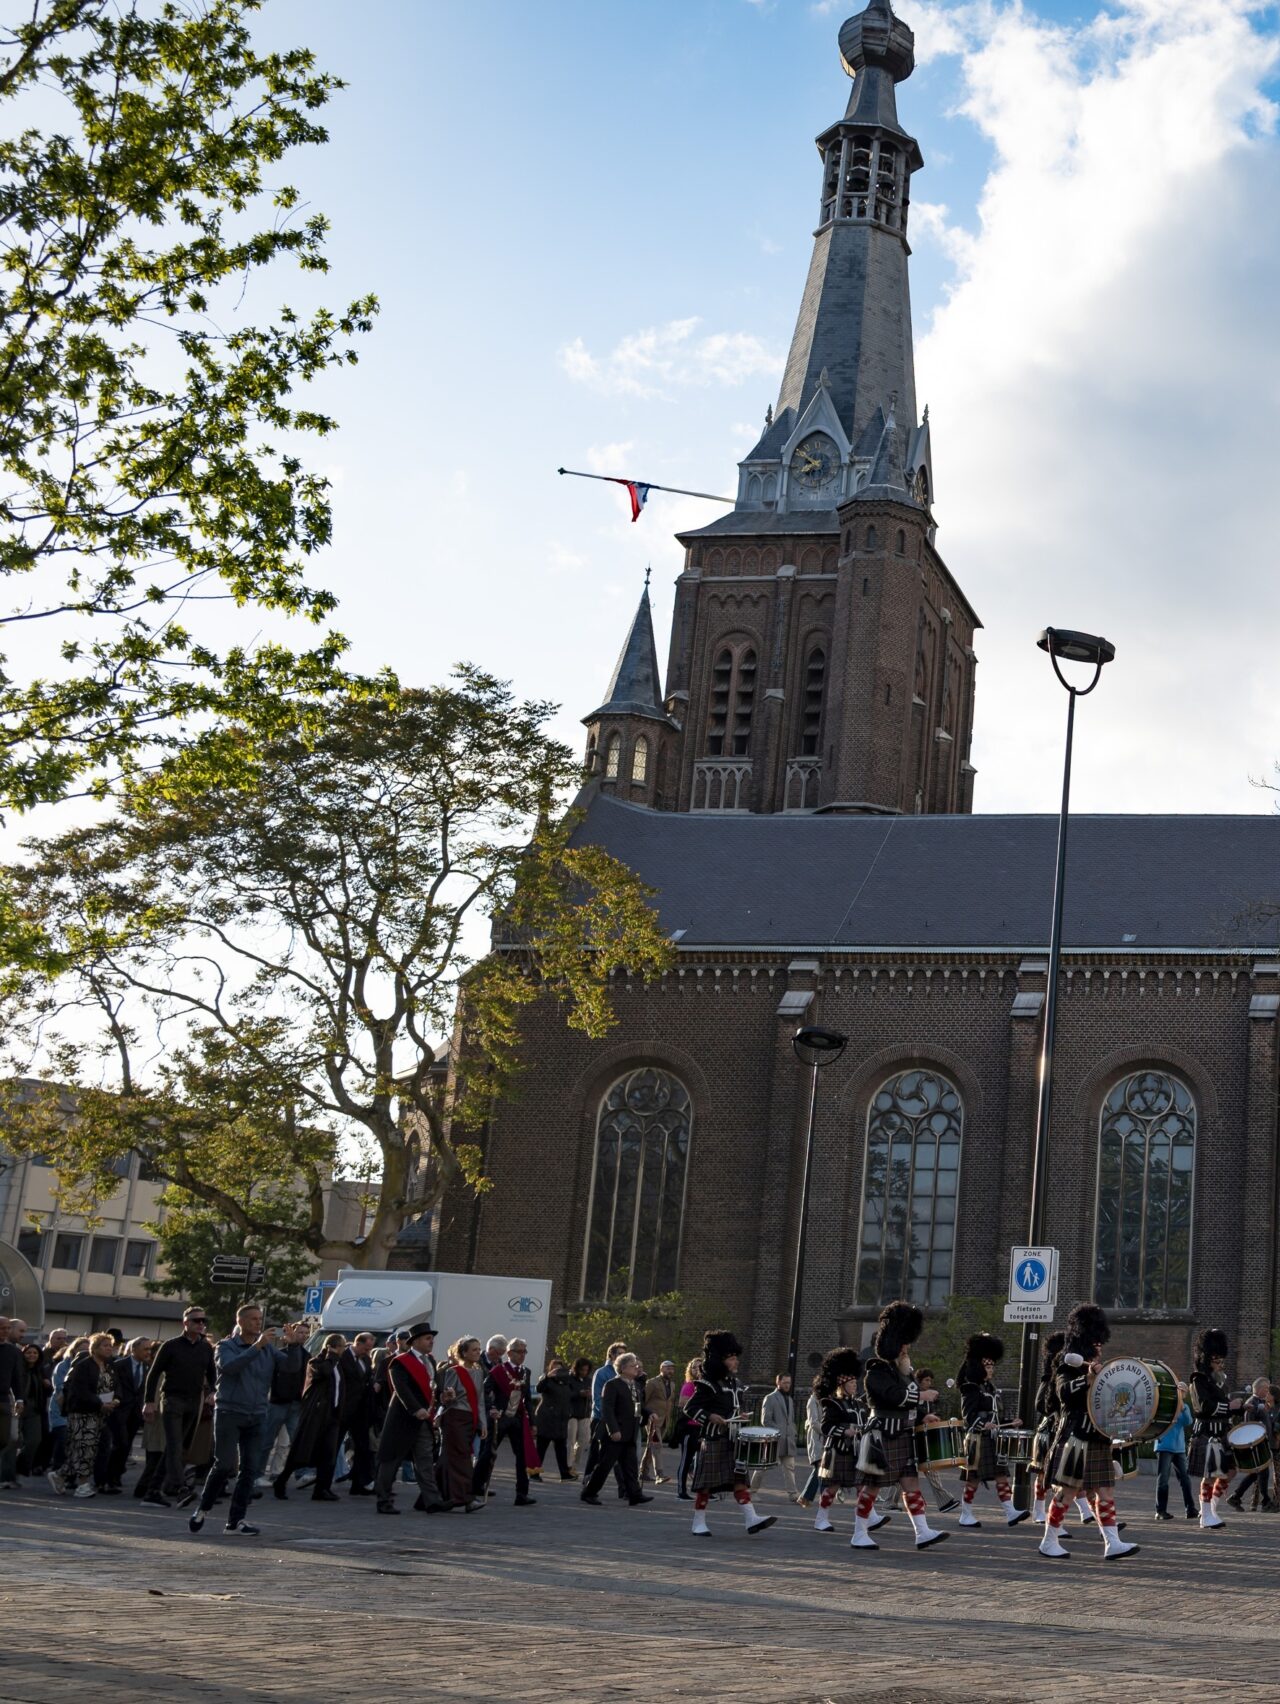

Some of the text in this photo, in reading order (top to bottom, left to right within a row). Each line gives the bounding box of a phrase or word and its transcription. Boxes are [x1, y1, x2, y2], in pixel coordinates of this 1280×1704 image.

[310, 1290, 319, 1304] P
[1095, 1364, 1152, 1410] DUTCH PIPES AND DRUMS
